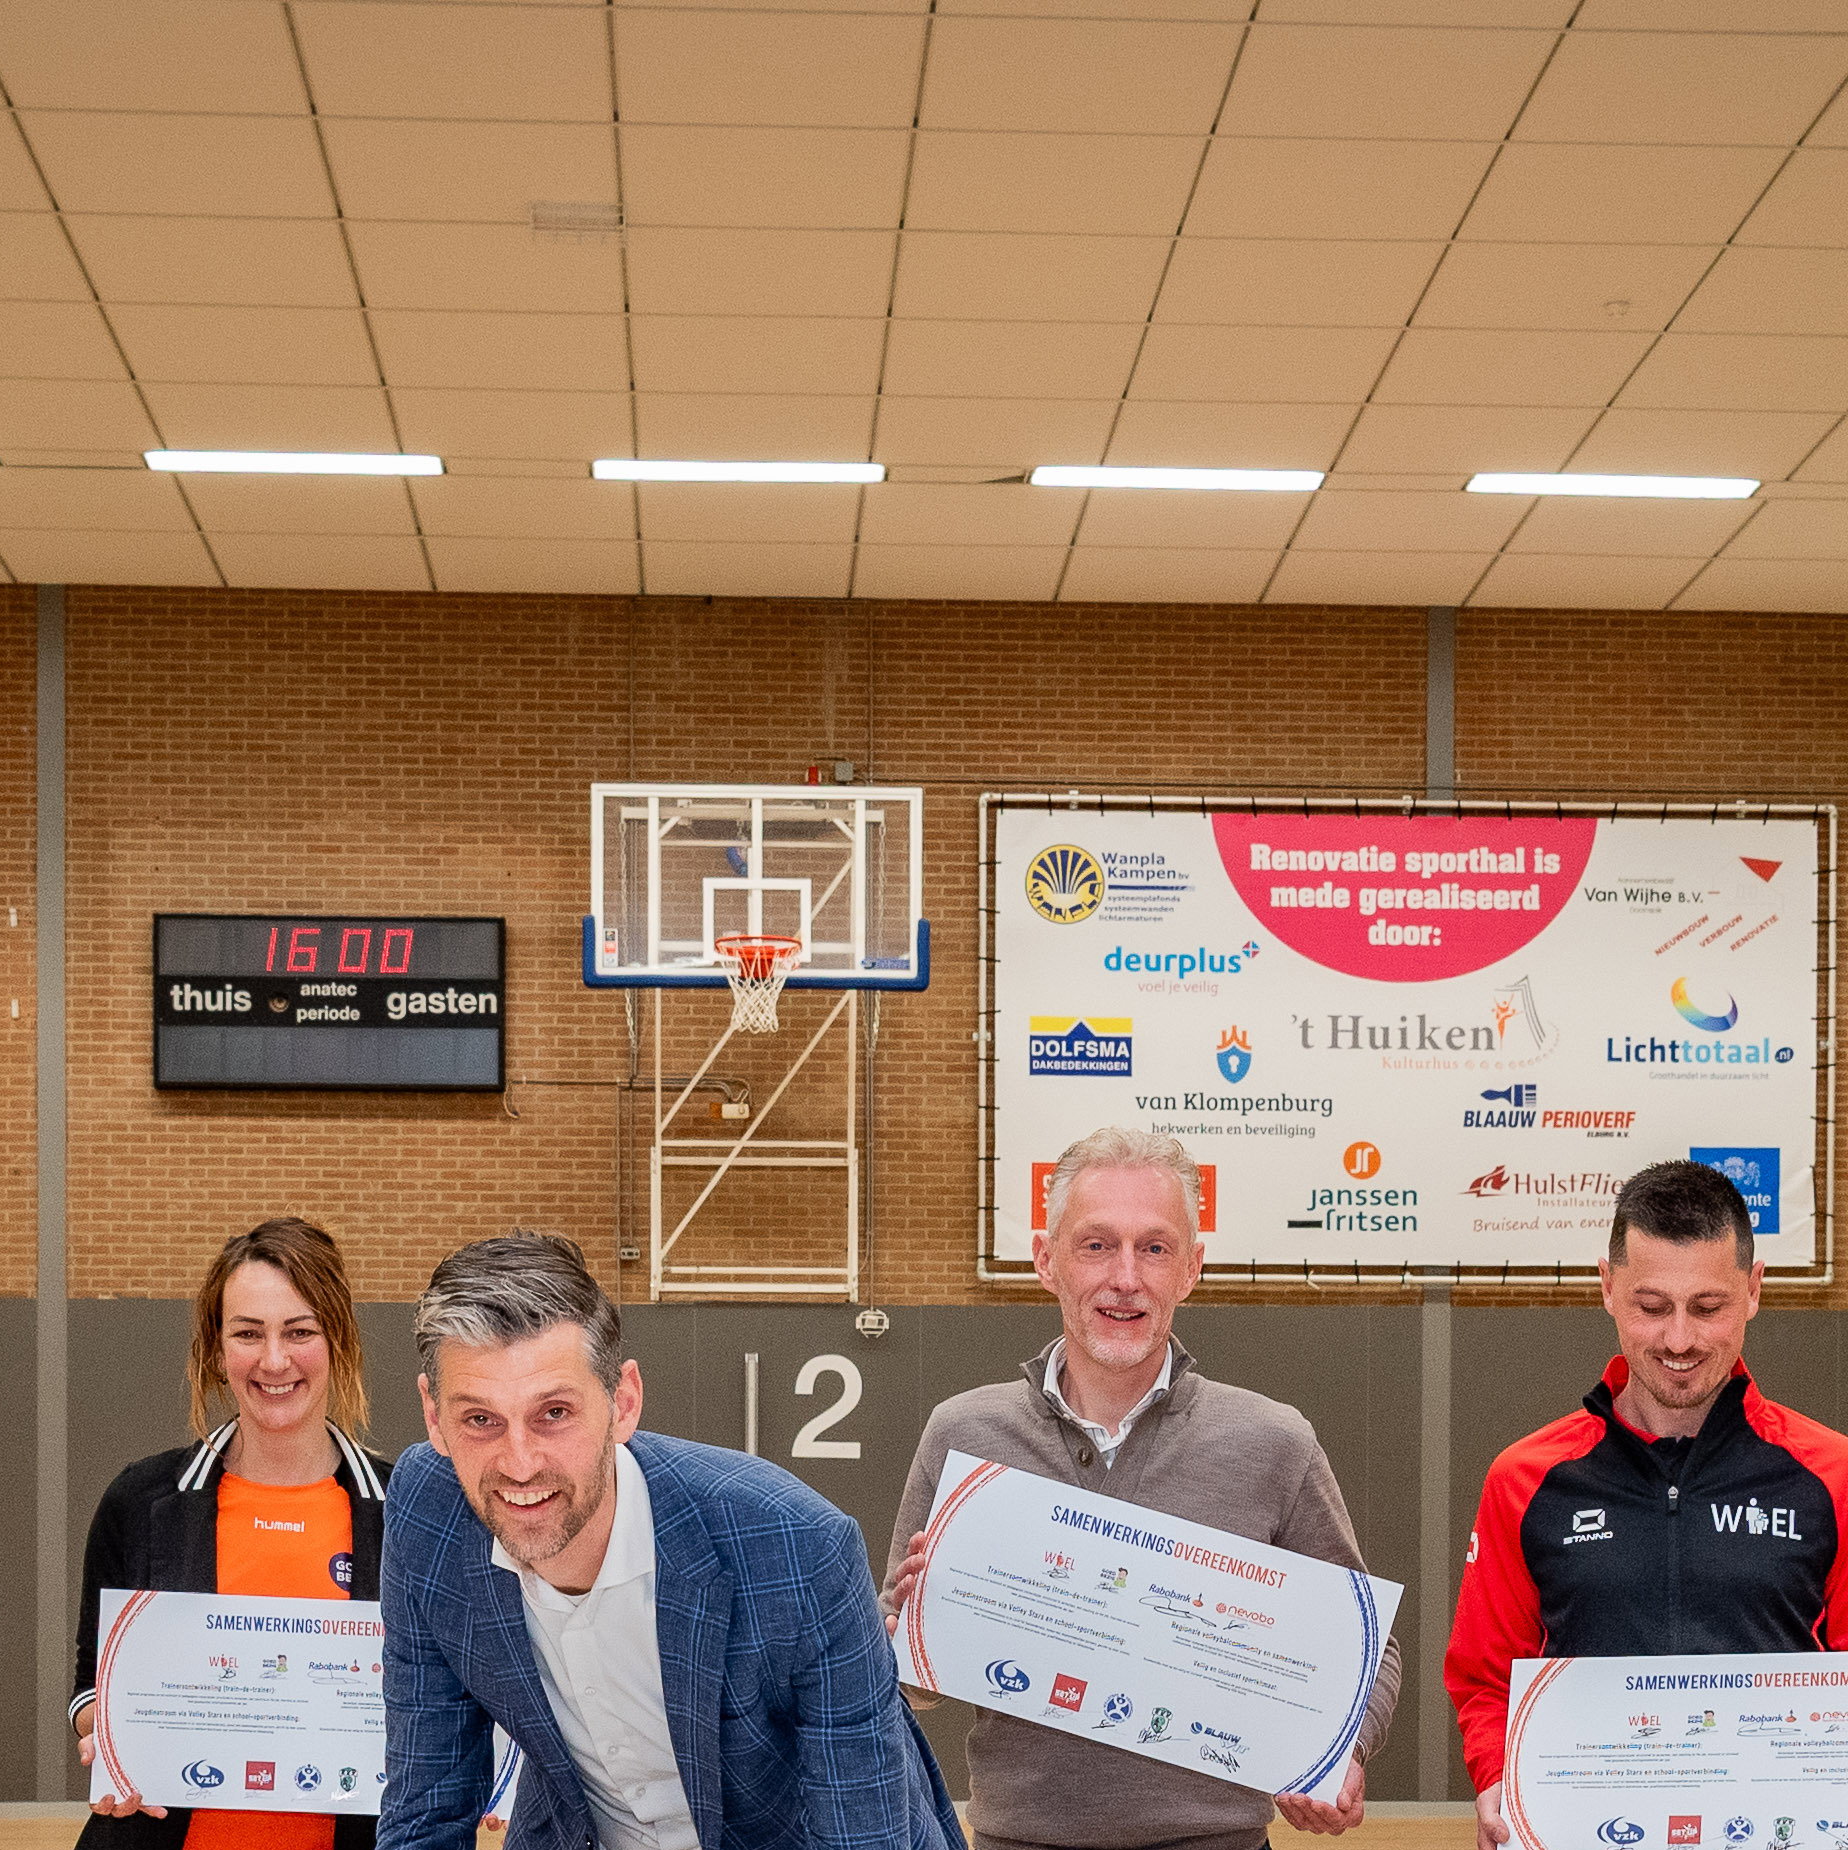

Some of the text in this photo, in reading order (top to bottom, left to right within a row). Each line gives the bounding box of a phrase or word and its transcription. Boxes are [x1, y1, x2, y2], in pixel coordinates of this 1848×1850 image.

[1102, 852, 1166, 867] Wanpla
[1251, 844, 1560, 878] Renovatie sporthal is
[1108, 866, 1176, 880] Kampen
[1270, 882, 1540, 915] mede gerealiseerd
[1584, 887, 1703, 905] Van Wijhe B.V.
[1369, 919, 1442, 946] door:
[1654, 914, 1709, 956] NIEUWBOUW
[1699, 914, 1743, 948] VERBOUW
[1729, 913, 1779, 952] RENOVATIE
[1104, 946, 1242, 979] deurplus
[300, 983, 358, 997] anatec
[1138, 980, 1219, 996] voel je veilig
[170, 983, 498, 1020] thuis gasten
[296, 1007, 361, 1023] periode
[1327, 1014, 1496, 1051] Huiken
[1031, 1040, 1130, 1058] DOLFSMA
[1032, 1060, 1129, 1071] DAKBEDEKKINGEN
[1382, 1056, 1459, 1070] Kulturhus
[1135, 1093, 1333, 1117] van Klompenburg
[1463, 1110, 1636, 1129] BLAAUW PERIOVERF
[1152, 1122, 1316, 1139] hekwerken en beveiliging
[1514, 1173, 1626, 1196] HulstFlie
[1307, 1187, 1418, 1211] janssen
[1537, 1198, 1613, 1208] Installateur
[1325, 1210, 1418, 1233] fritsen
[1473, 1218, 1538, 1232] Bruisend
[1546, 1221, 1573, 1230] van
[791, 1354, 863, 1459] 2
[254, 1517, 305, 1533] hummel
[1050, 1504, 1287, 1590] SAMENWERKINGSOVEREENKOMST
[1563, 1531, 1614, 1545] STANNO
[1148, 1582, 1191, 1604] Rabobank
[1227, 1603, 1276, 1626] nevobo
[308, 1661, 347, 1671] Rabobank
[998, 1674, 1025, 1691] vzk
[1738, 1713, 1782, 1723] Rabobank
[1203, 1726, 1242, 1745] BLAUW
[196, 1774, 219, 1785] vzk
[1613, 1831, 1639, 1841] vzk
